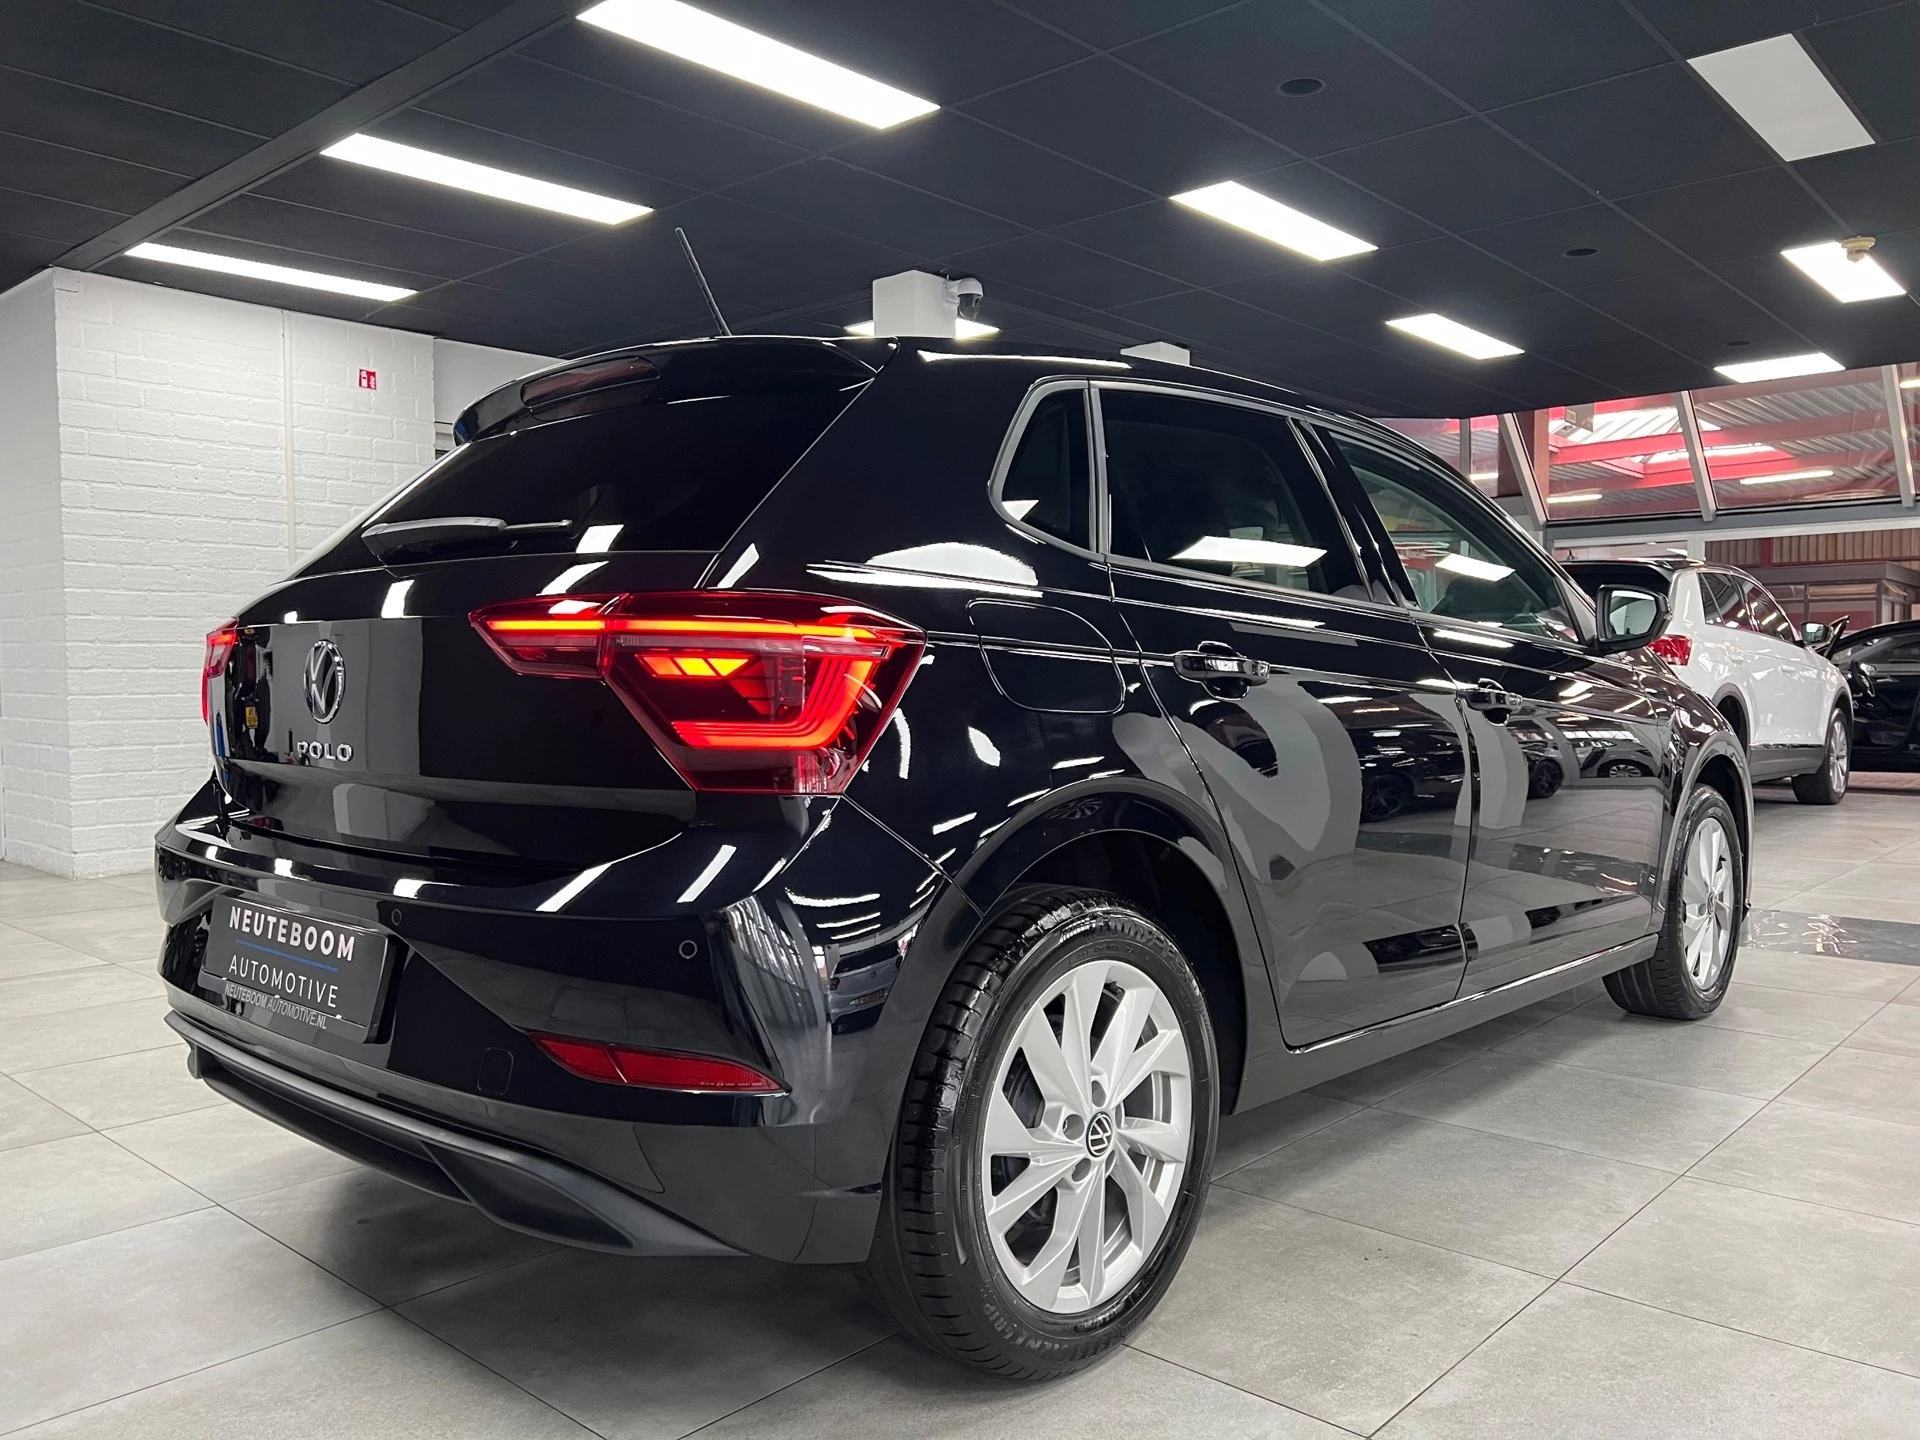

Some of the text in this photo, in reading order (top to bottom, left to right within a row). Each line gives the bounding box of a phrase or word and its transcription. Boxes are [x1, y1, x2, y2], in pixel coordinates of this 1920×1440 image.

[297, 741, 353, 762] POLO
[229, 905, 355, 962] NEUTEBOOM
[224, 982, 327, 1030] NEUTEBOOM AUTOMOTIVE.NL
[228, 954, 339, 1008] AUTOMOTIVE
